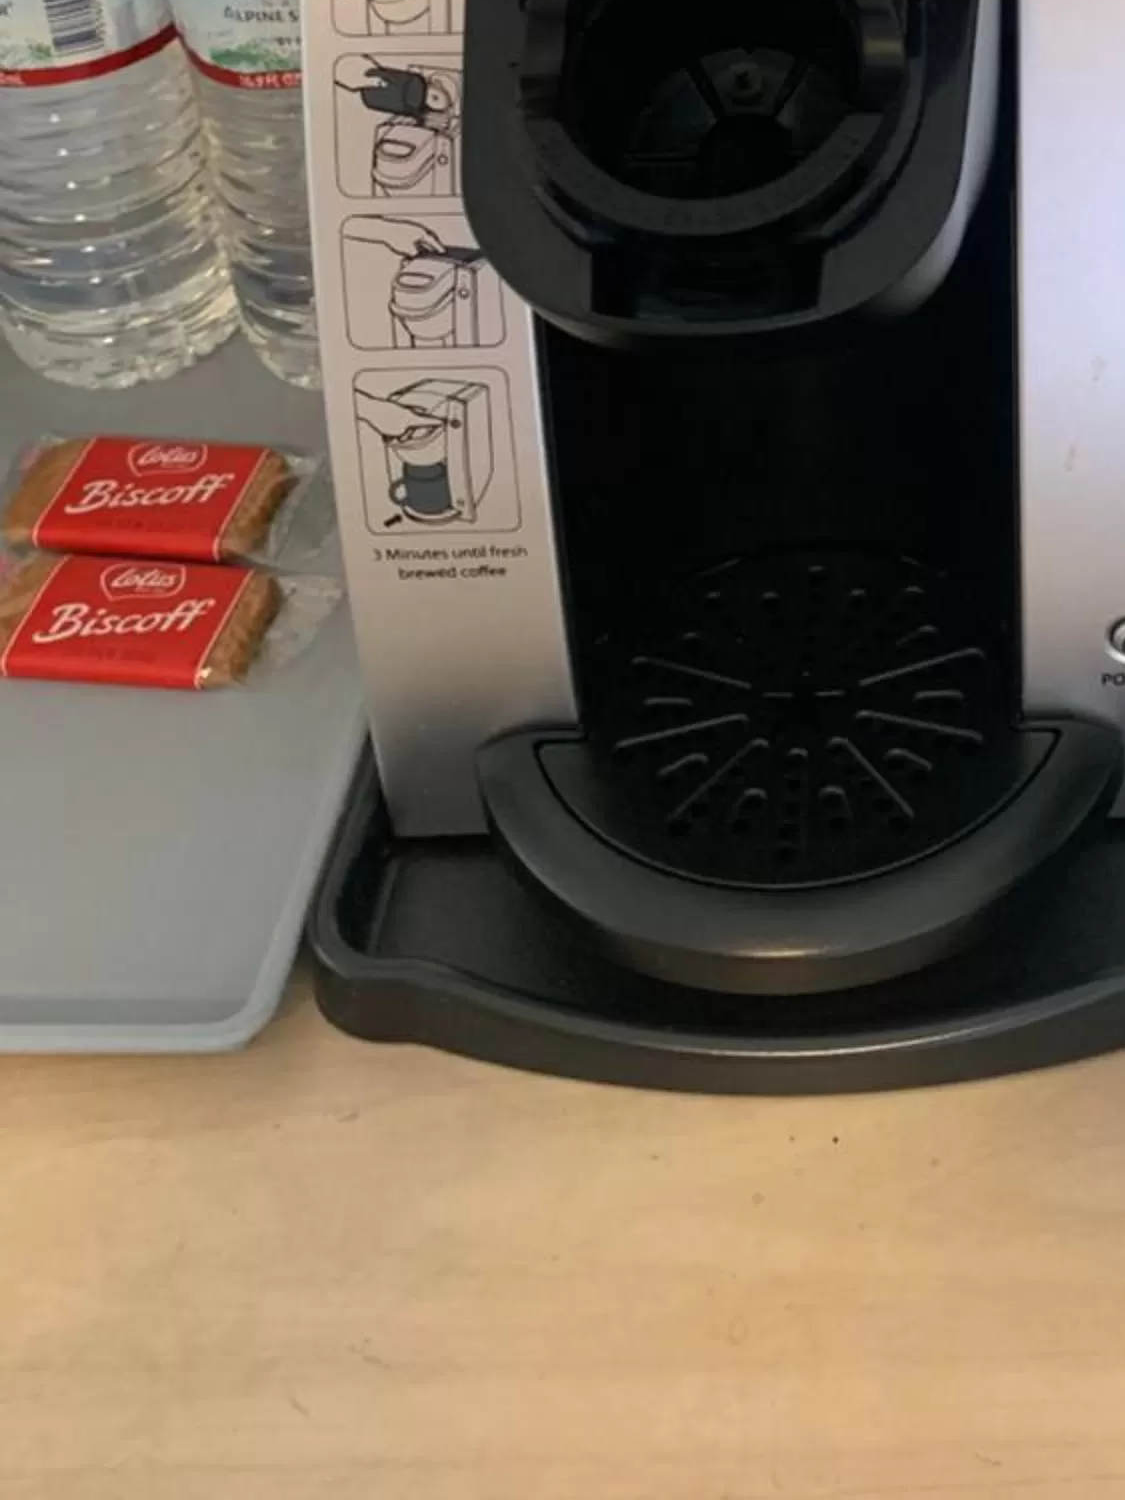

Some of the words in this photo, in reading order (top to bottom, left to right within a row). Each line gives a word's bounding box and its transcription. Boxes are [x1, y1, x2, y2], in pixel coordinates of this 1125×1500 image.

[137, 445, 198, 467] Lotus
[64, 473, 236, 515] Biscoff
[386, 547, 449, 561] Minutes
[452, 544, 487, 560] until
[490, 543, 529, 557] fresh
[110, 567, 178, 588] Lotus
[398, 565, 457, 580] brewed
[459, 564, 508, 578] coffee
[32, 599, 216, 644] Biscoff
